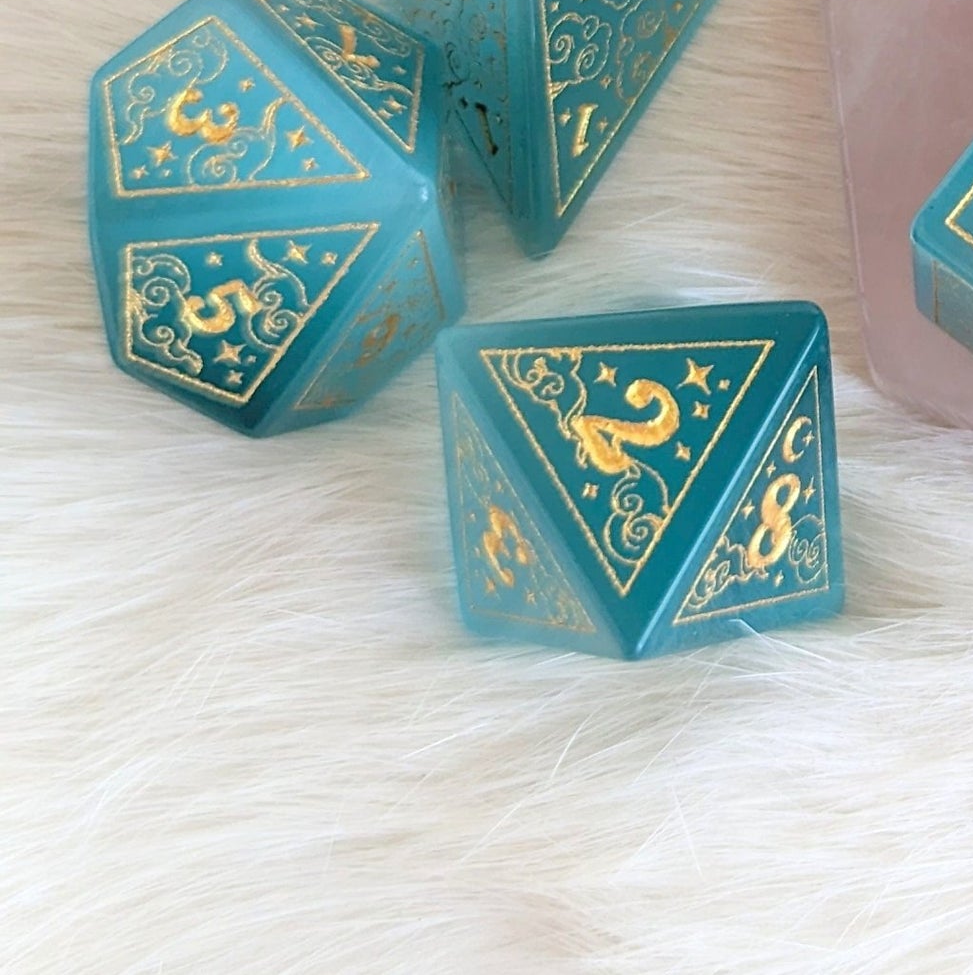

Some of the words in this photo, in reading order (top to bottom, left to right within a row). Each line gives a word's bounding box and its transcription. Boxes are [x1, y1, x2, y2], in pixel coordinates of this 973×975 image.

[167, 87, 240, 146] 3
[474, 102, 499, 157] 1
[572, 102, 599, 157] 1
[184, 278, 263, 335] 5
[570, 378, 680, 475] 2
[746, 472, 801, 569] 8
